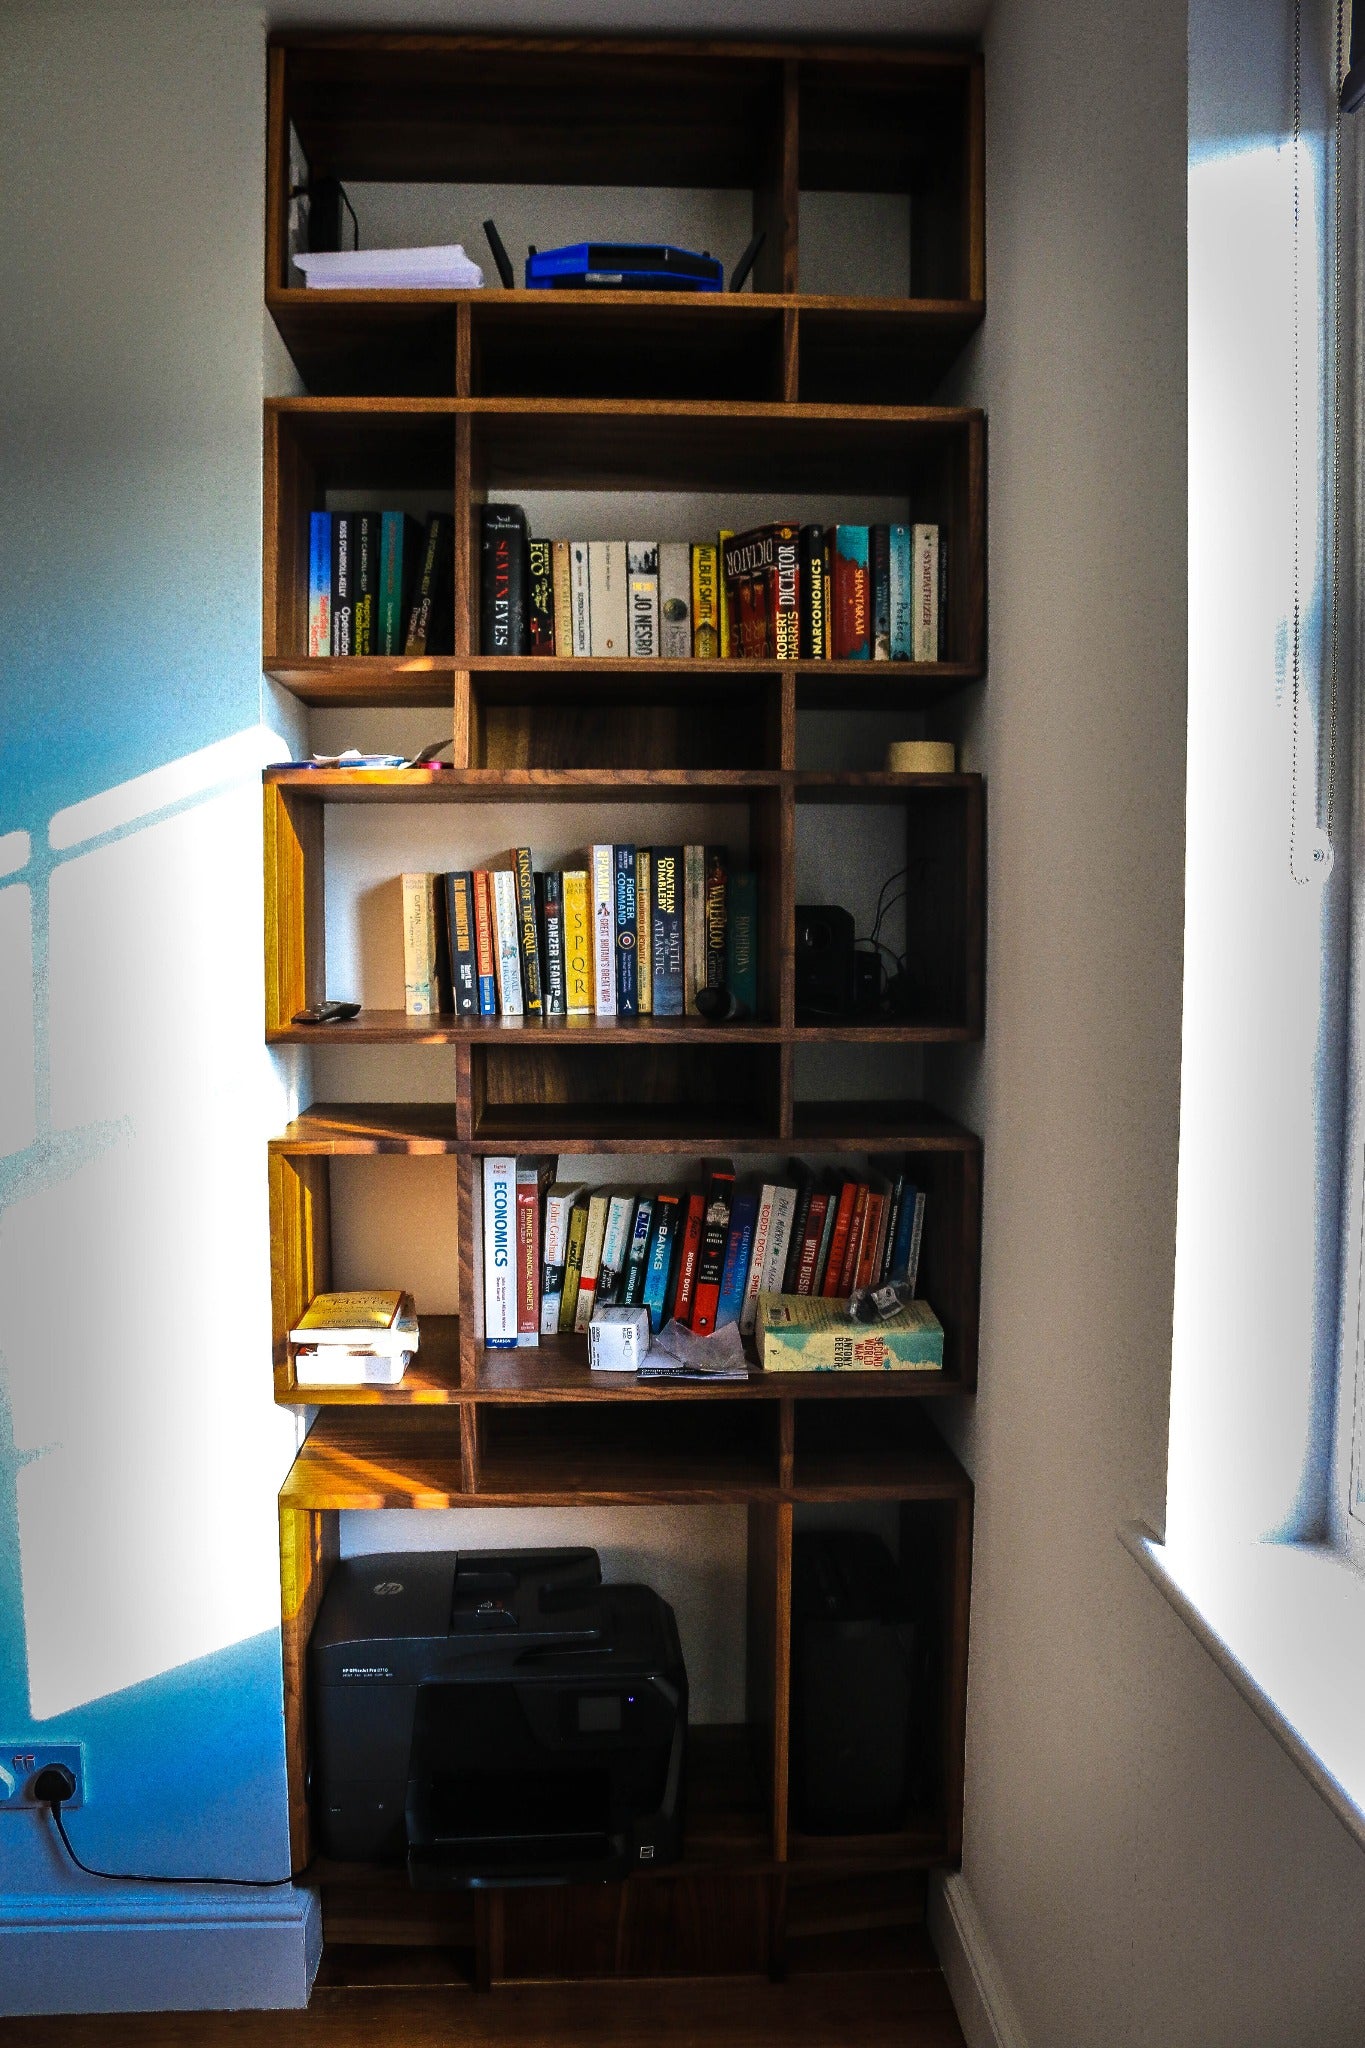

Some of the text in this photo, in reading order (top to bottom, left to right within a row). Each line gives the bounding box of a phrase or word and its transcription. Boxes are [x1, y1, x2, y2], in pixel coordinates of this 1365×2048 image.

[530, 543, 544, 576] ECO
[727, 538, 773, 576] DICTATOR
[778, 545, 795, 606] DICTATOR
[634, 594, 652, 611] JO
[699, 548, 713, 619] WILBUR SMITH
[854, 569, 865, 635] SHANTARAM
[923, 551, 932, 626] SYMPATHIZER
[812, 558, 822, 655] NARCONOMICS
[341, 606, 351, 656] Operation
[776, 611, 788, 660] ROBERT
[788, 611, 799, 660] HARRIS
[453, 878, 466, 890] THE
[518, 850, 532, 887] KINGS
[597, 856, 610, 903] PAXMAN
[657, 859, 666, 912] DIMBLEBY
[664, 857, 675, 913] JONATHAN
[454, 891, 469, 937] MONUMENTS
[521, 889, 532, 902] OF
[522, 904, 533, 924] THE
[617, 871, 627, 925] COMMAND
[626, 878, 635, 919] FIGHTER
[709, 885, 725, 949] WATERLOO
[457, 936, 470, 952] MEN
[523, 924, 536, 957] GRAIL
[547, 917, 561, 997] PANZER LEADER
[599, 918, 611, 1003] GREAT BRITAIN'S GREAT WAR
[654, 920, 664, 975] ATLANTIC
[669, 932, 680, 973] BATTLE
[502, 960, 511, 1003] FERGUSON
[510, 967, 519, 991] NIALL
[494, 1181, 508, 1268] ECONOMICS
[777, 1199, 789, 1221] PAUL
[547, 1202, 561, 1262] John Grisham
[654, 1226, 668, 1270] BANKS
[738, 1225, 751, 1270] CHRISTOS
[750, 1203, 771, 1300] RODDY DOYLE SMILE
[803, 1239, 818, 1264] WITH
[526, 1245, 534, 1279] FINANCIAL
[568, 1241, 577, 1273] JACKAL
[681, 1252, 694, 1302] RODDY DOYLE
[526, 1280, 534, 1311] MARKETS
[545, 1266, 553, 1293] Racketeer
[627, 1267, 638, 1293] LINWOOD
[799, 1264, 812, 1296] RUSSI
[834, 1337, 844, 1368] BEEVOR
[843, 1337, 853, 1367] ANTONY
[854, 1343, 864, 1361] WAR
[864, 1338, 873, 1366] WORLD
[874, 1336, 883, 1367] SECOND
